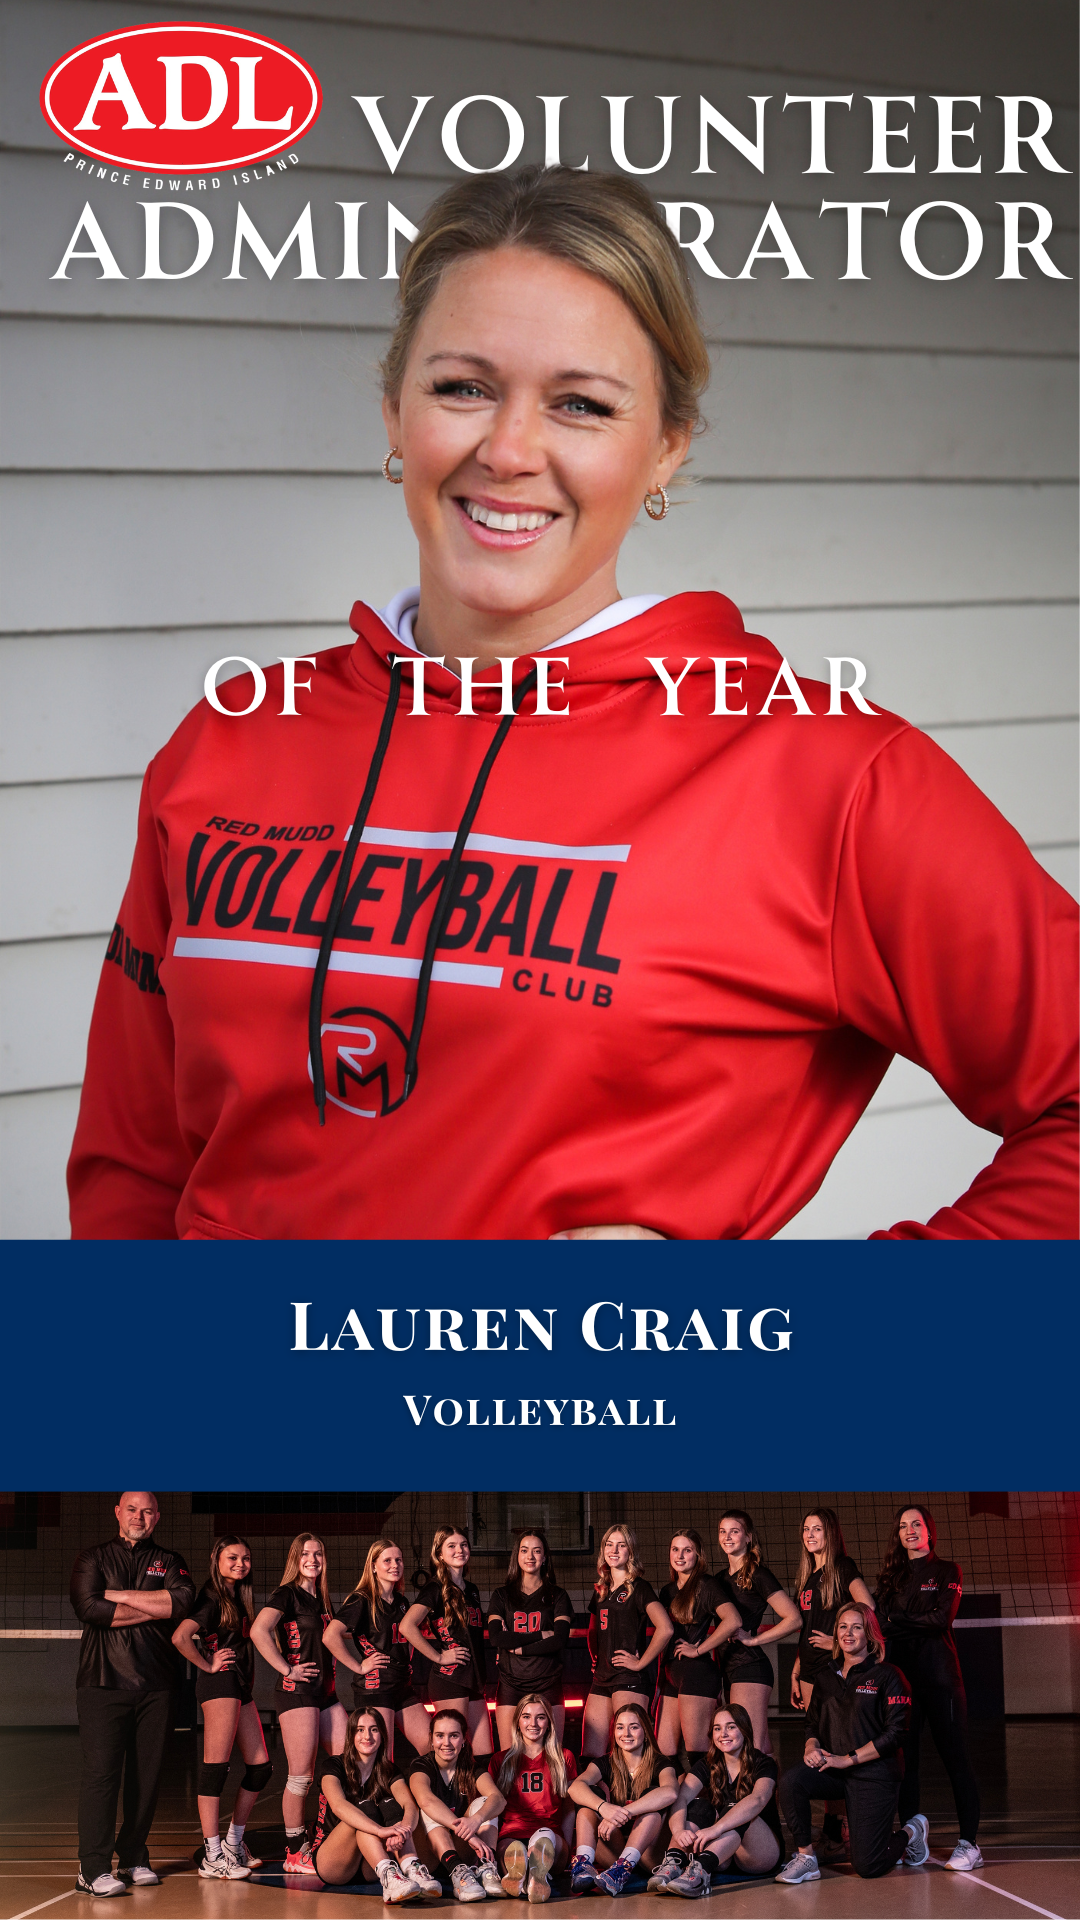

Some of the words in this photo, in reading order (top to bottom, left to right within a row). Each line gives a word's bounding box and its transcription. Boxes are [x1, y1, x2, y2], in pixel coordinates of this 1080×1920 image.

[206, 815, 262, 836] RED
[263, 824, 335, 842] MUDD
[186, 831, 621, 975] VOLLEYBALL
[512, 968, 615, 1008] CLUB
[467, 1607, 483, 1627] 21
[513, 1610, 542, 1633] 20
[600, 1608, 609, 1631] 5
[521, 1772, 544, 1793] 18
